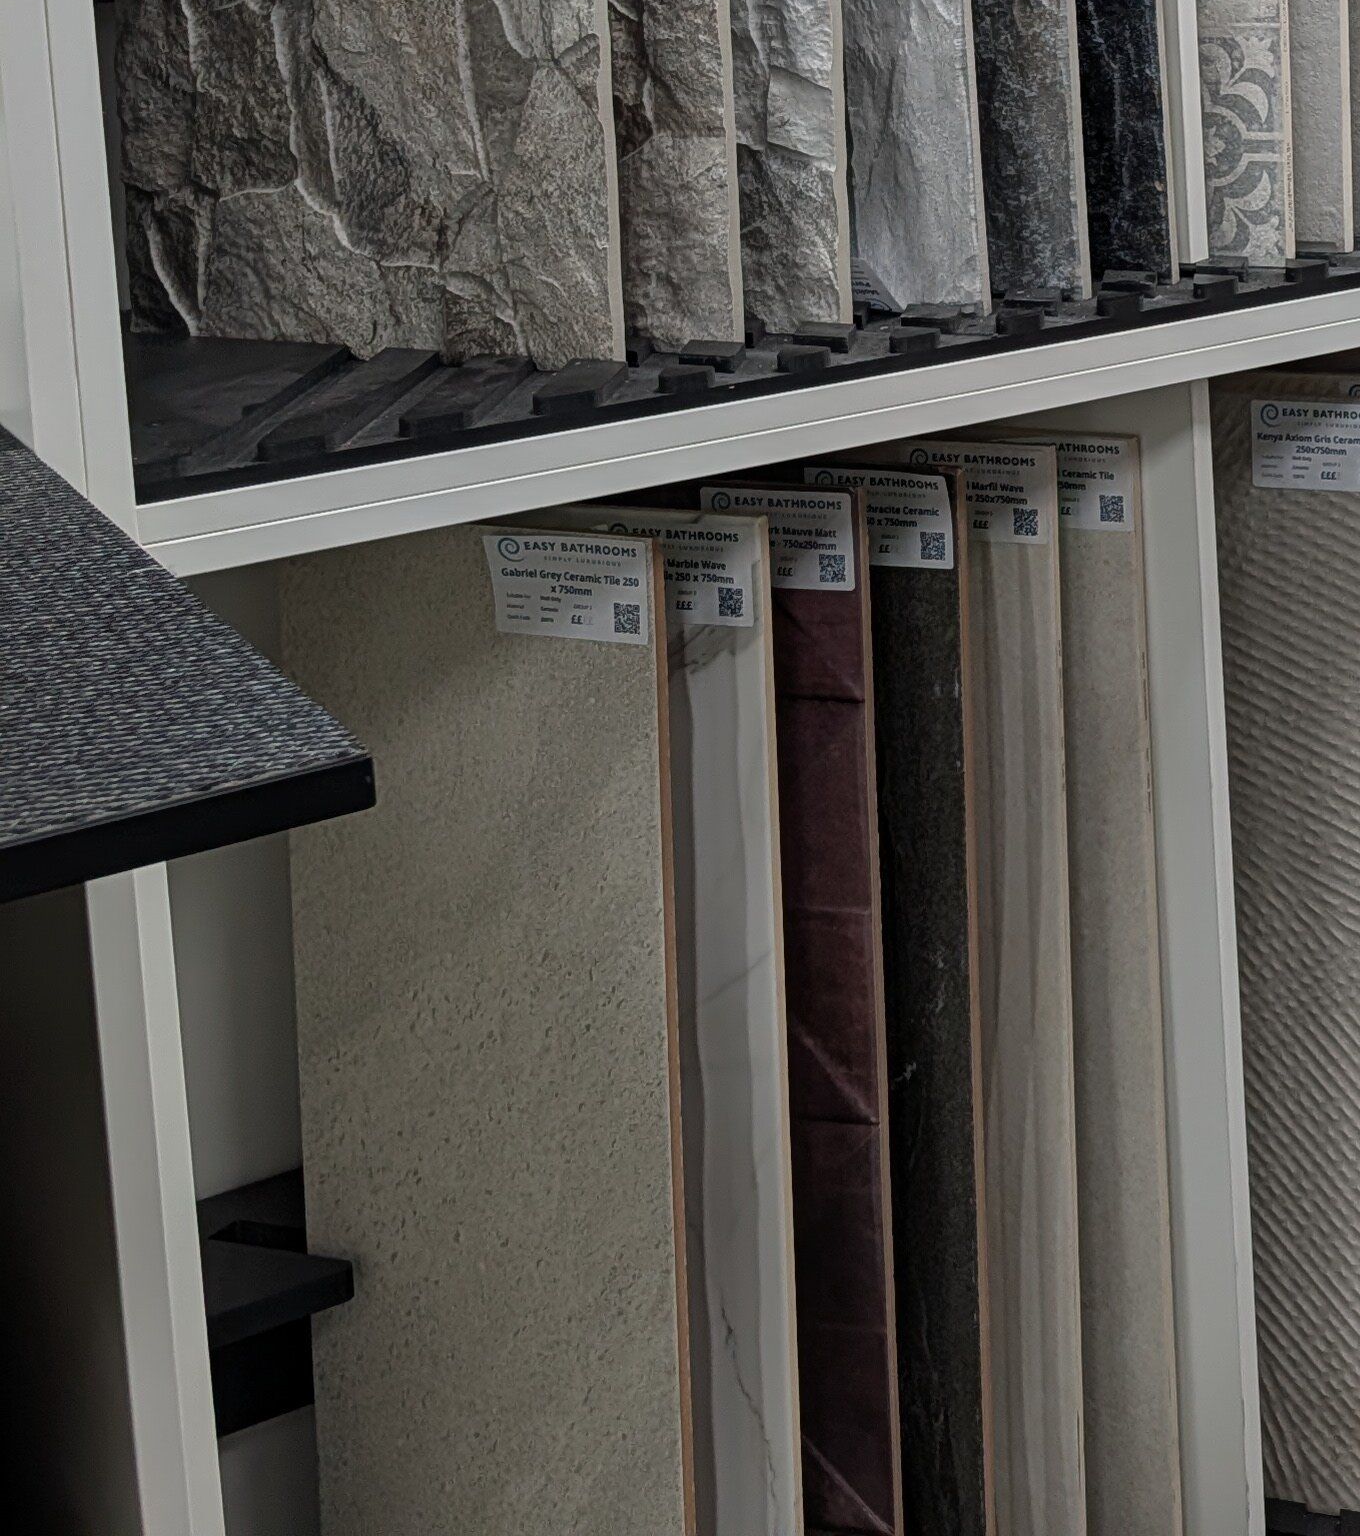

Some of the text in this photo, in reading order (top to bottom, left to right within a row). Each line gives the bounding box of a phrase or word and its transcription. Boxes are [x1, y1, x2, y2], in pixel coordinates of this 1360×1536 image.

[1282, 408, 1309, 417] EASY
[1257, 433, 1283, 443] Kenya
[1285, 433, 1312, 443] Axiom
[1314, 435, 1331, 444] Gris
[1296, 446, 1347, 456] 250x750mm
[932, 452, 1036, 467] EASY BATHROOMS
[1062, 470, 1114, 480] Ceramic Tile
[838, 475, 939, 490] EASY BATHROOMS
[971, 482, 1024, 493] Marfil Wave
[734, 497, 842, 511] EASY BATHROOMS
[974, 495, 1027, 505] 250x750mm
[903, 506, 939, 516] Ceramic
[885, 518, 917, 527] 750mm
[666, 529, 739, 542] BATHROOMS
[782, 527, 837, 537] Mauve Matt
[524, 541, 637, 558] EASY BATHROOMS
[783, 540, 837, 551] 750x250mm
[667, 559, 726, 571] Marble Wave
[501, 567, 639, 587] Gabriel Grey Ceramic Tile 250
[675, 572, 734, 585] 250 750mm
[558, 585, 592, 596] 750mm
